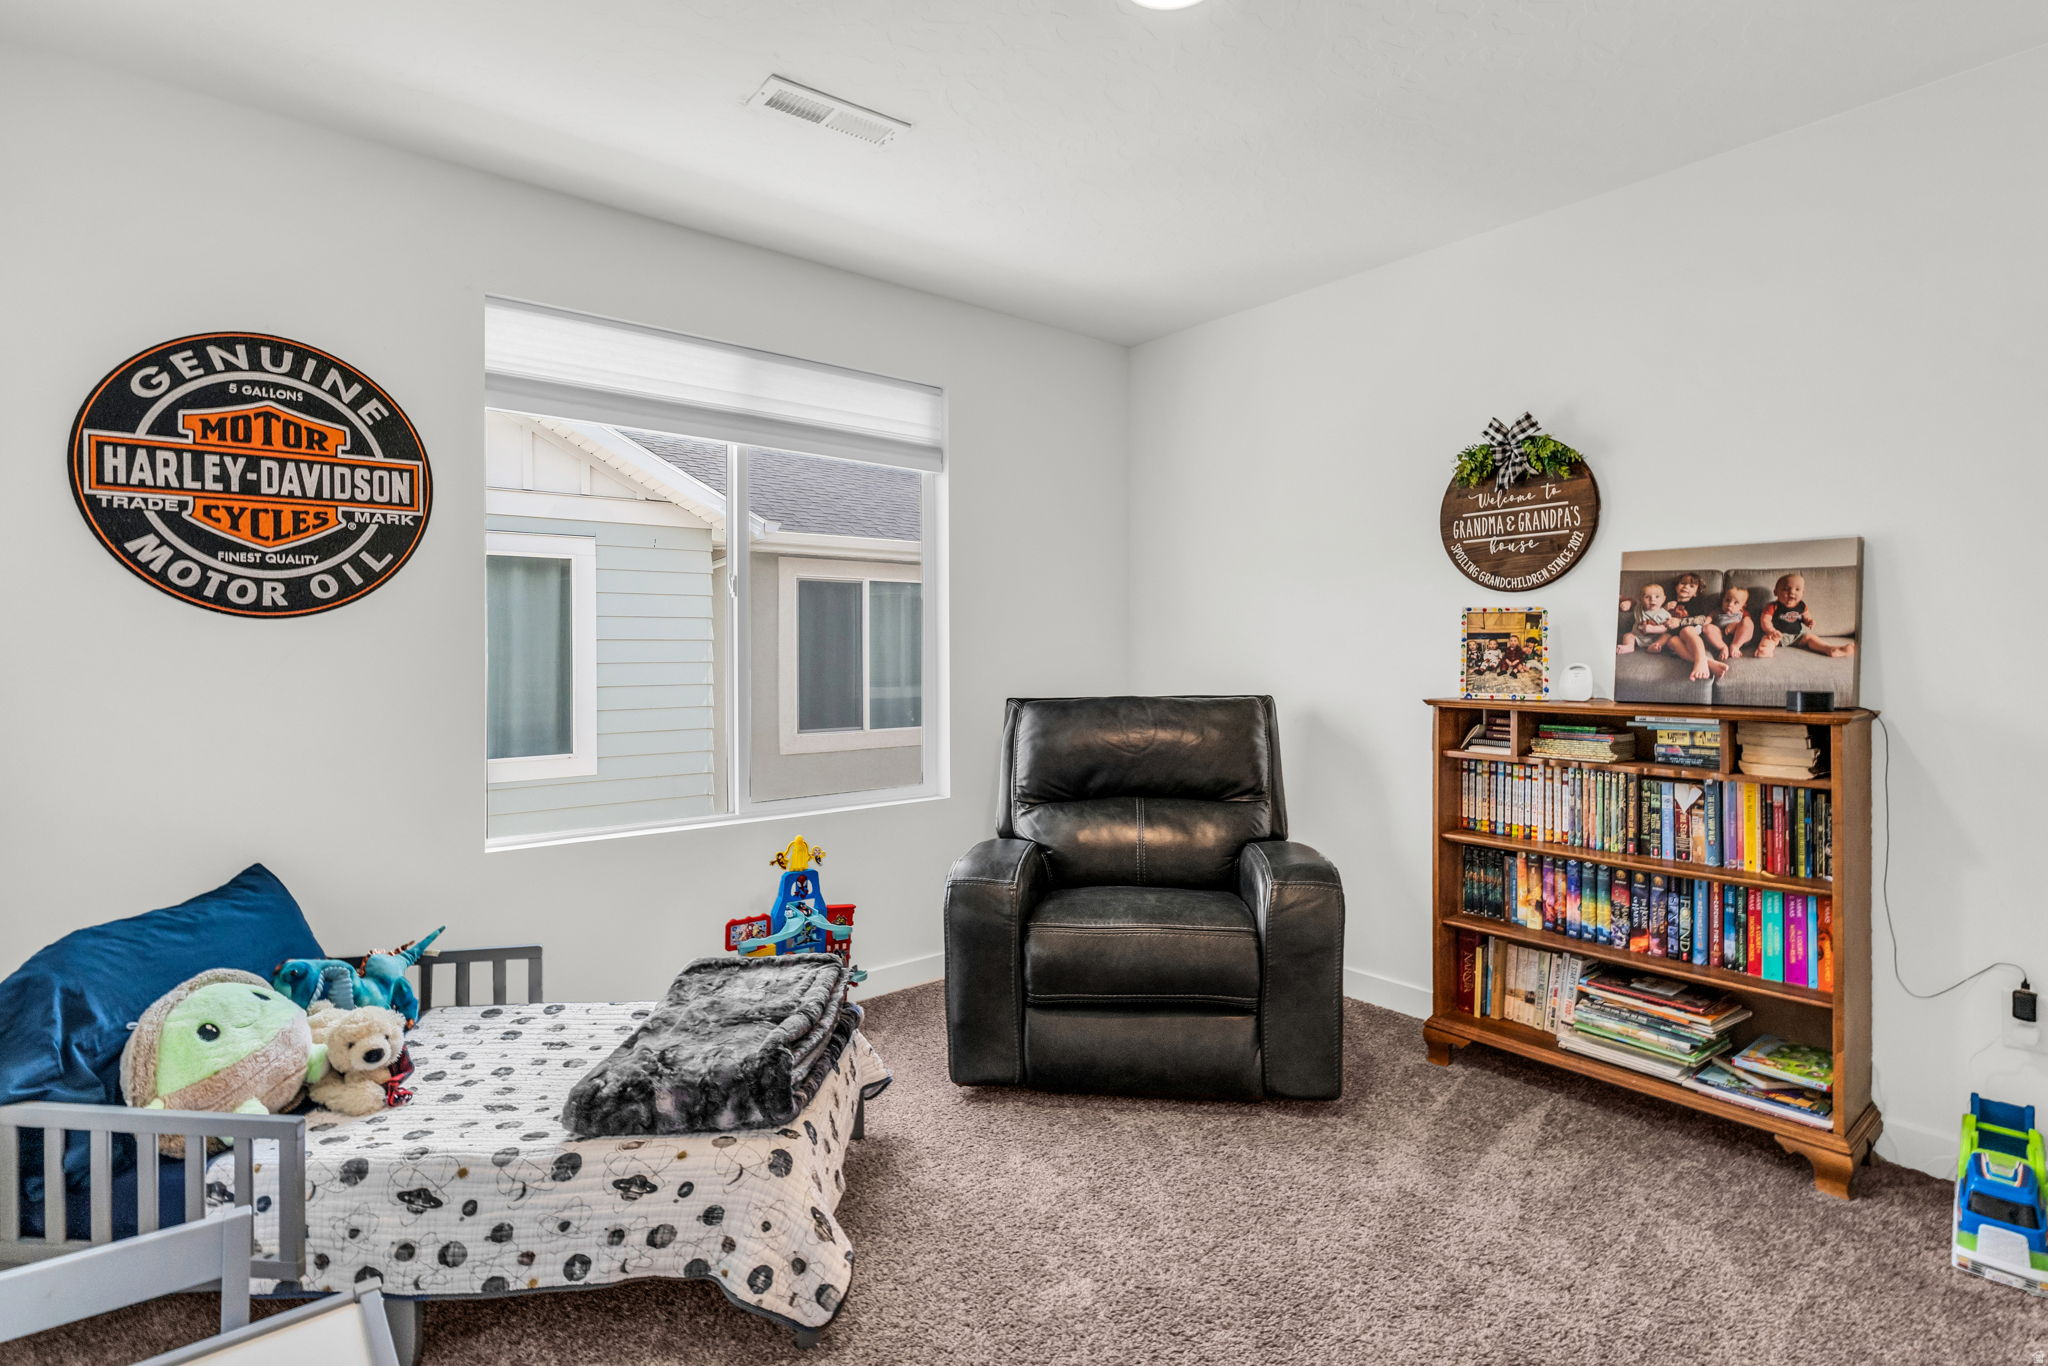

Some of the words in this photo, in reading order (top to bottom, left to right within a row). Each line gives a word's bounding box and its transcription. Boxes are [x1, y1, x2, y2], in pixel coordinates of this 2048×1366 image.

[130, 343, 390, 426] GENUINE
[228, 383, 237, 394] 5
[241, 385, 304, 402] GALLONS
[198, 411, 330, 452] MOTOR
[103, 444, 410, 505] HARLEY-DAVIDSON
[98, 495, 179, 512] TRADE
[354, 512, 415, 527] MARK
[1468, 489, 1536, 509] Welcome
[1540, 482, 1562, 500] to
[202, 504, 331, 541] CYCLES
[1453, 516, 1504, 539] GRANDMA
[1506, 516, 1516, 531] &
[1518, 505, 1581, 532] GRANDPA'S
[218, 551, 262, 563] FINEST
[265, 551, 319, 565] QUALITY
[1450, 543, 1480, 577] SPOILING
[1478, 569, 1550, 589] GRANDCHILDREN
[1547, 548, 1573, 575] SINCE
[1566, 530, 1585, 553] 2022
[1489, 536, 1540, 554] house
[123, 532, 289, 606] MOTOR
[309, 550, 395, 599] OIL
